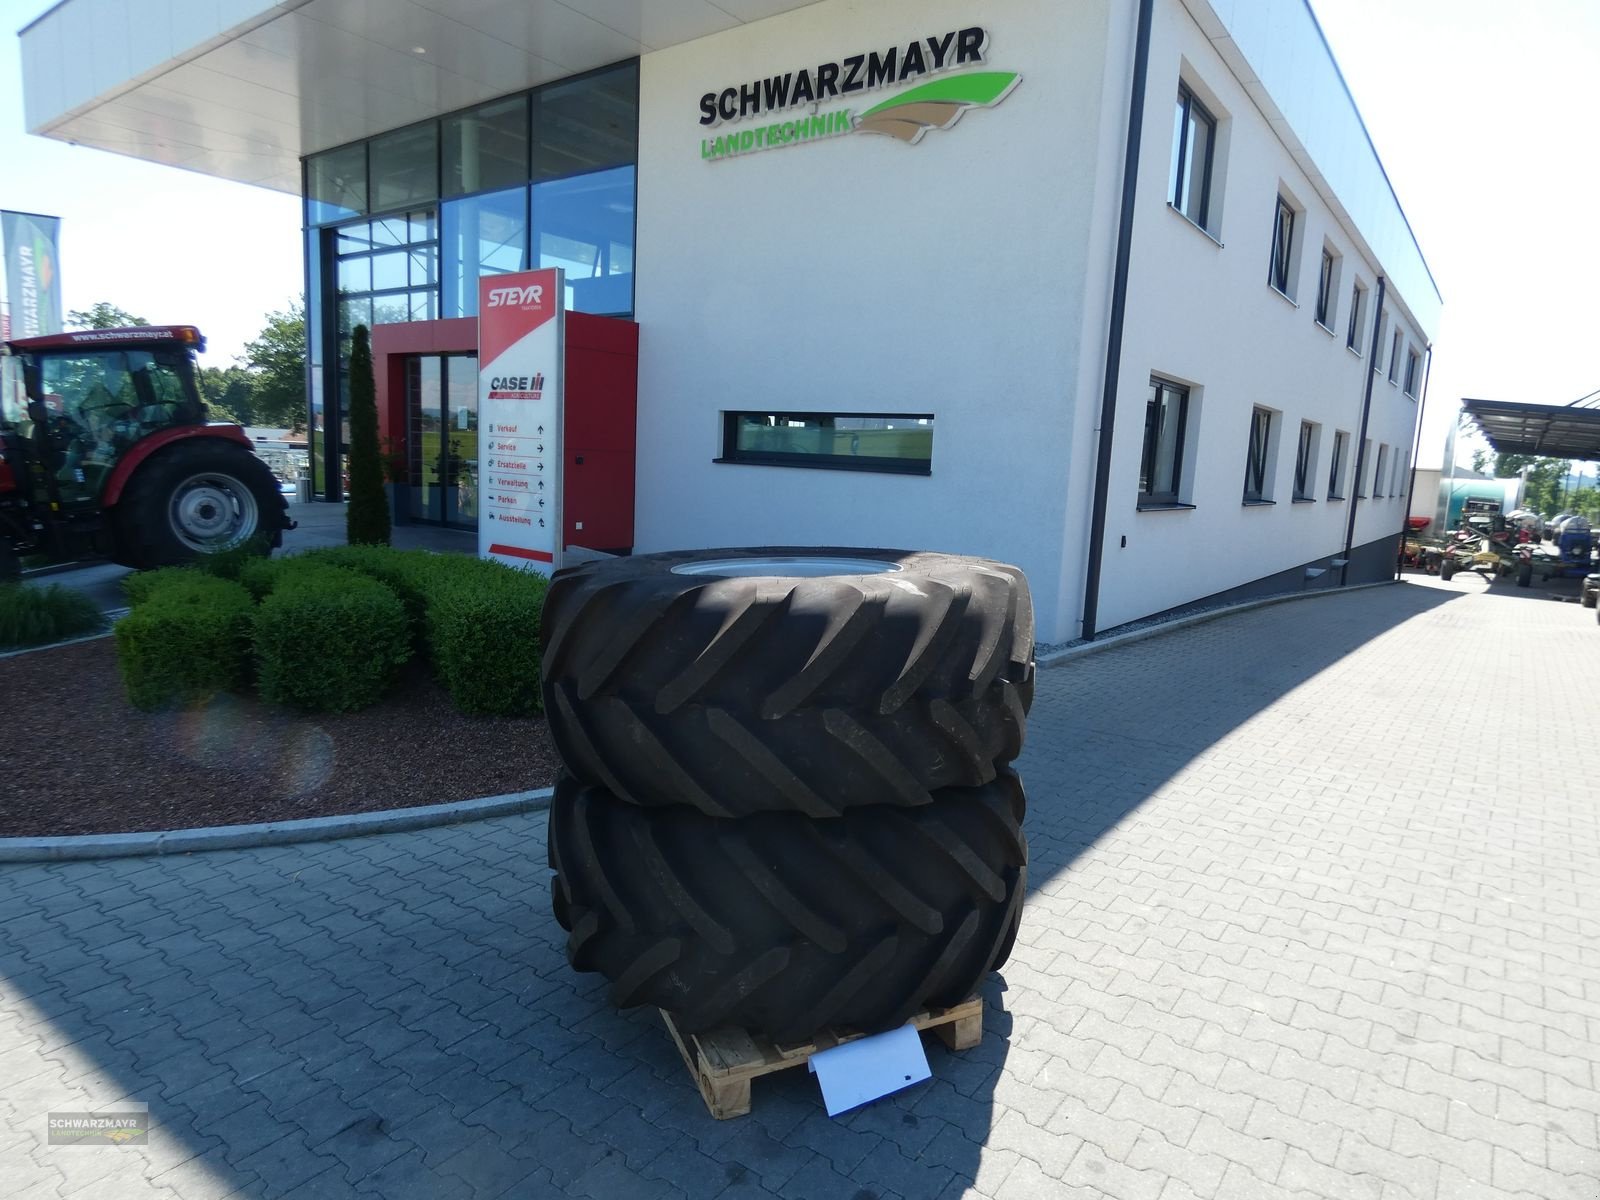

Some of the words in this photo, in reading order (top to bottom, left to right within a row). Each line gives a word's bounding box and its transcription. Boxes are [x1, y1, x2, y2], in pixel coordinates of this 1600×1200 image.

[699, 26, 987, 126] SCHWARZMAYR
[701, 108, 852, 160] LANDTECHNIK
[487, 285, 543, 308] STEYR
[72, 330, 174, 342] www.schwarzmayr.at
[490, 376, 529, 391] CASE
[496, 424, 518, 433] Verkauf
[497, 442, 517, 452] Service
[497, 478, 529, 489] Verwaltung
[498, 513, 532, 526] Ausstellung
